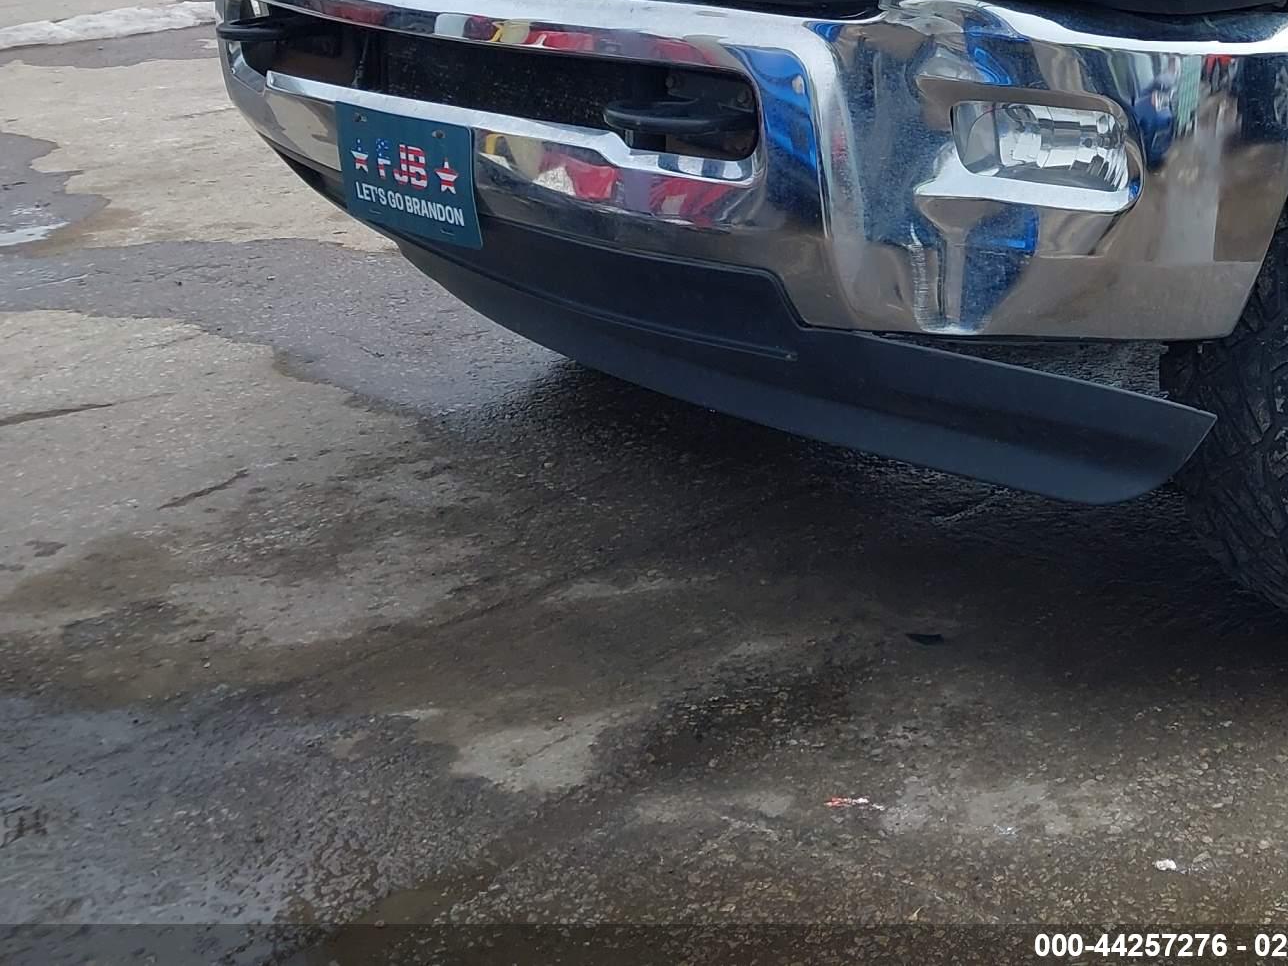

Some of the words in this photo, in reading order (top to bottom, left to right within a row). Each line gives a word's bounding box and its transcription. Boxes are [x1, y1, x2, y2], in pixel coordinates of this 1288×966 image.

[375, 138, 428, 190] FJB
[355, 182, 387, 206] LET'S
[387, 191, 404, 211] GO
[405, 196, 465, 227] BRANDON
